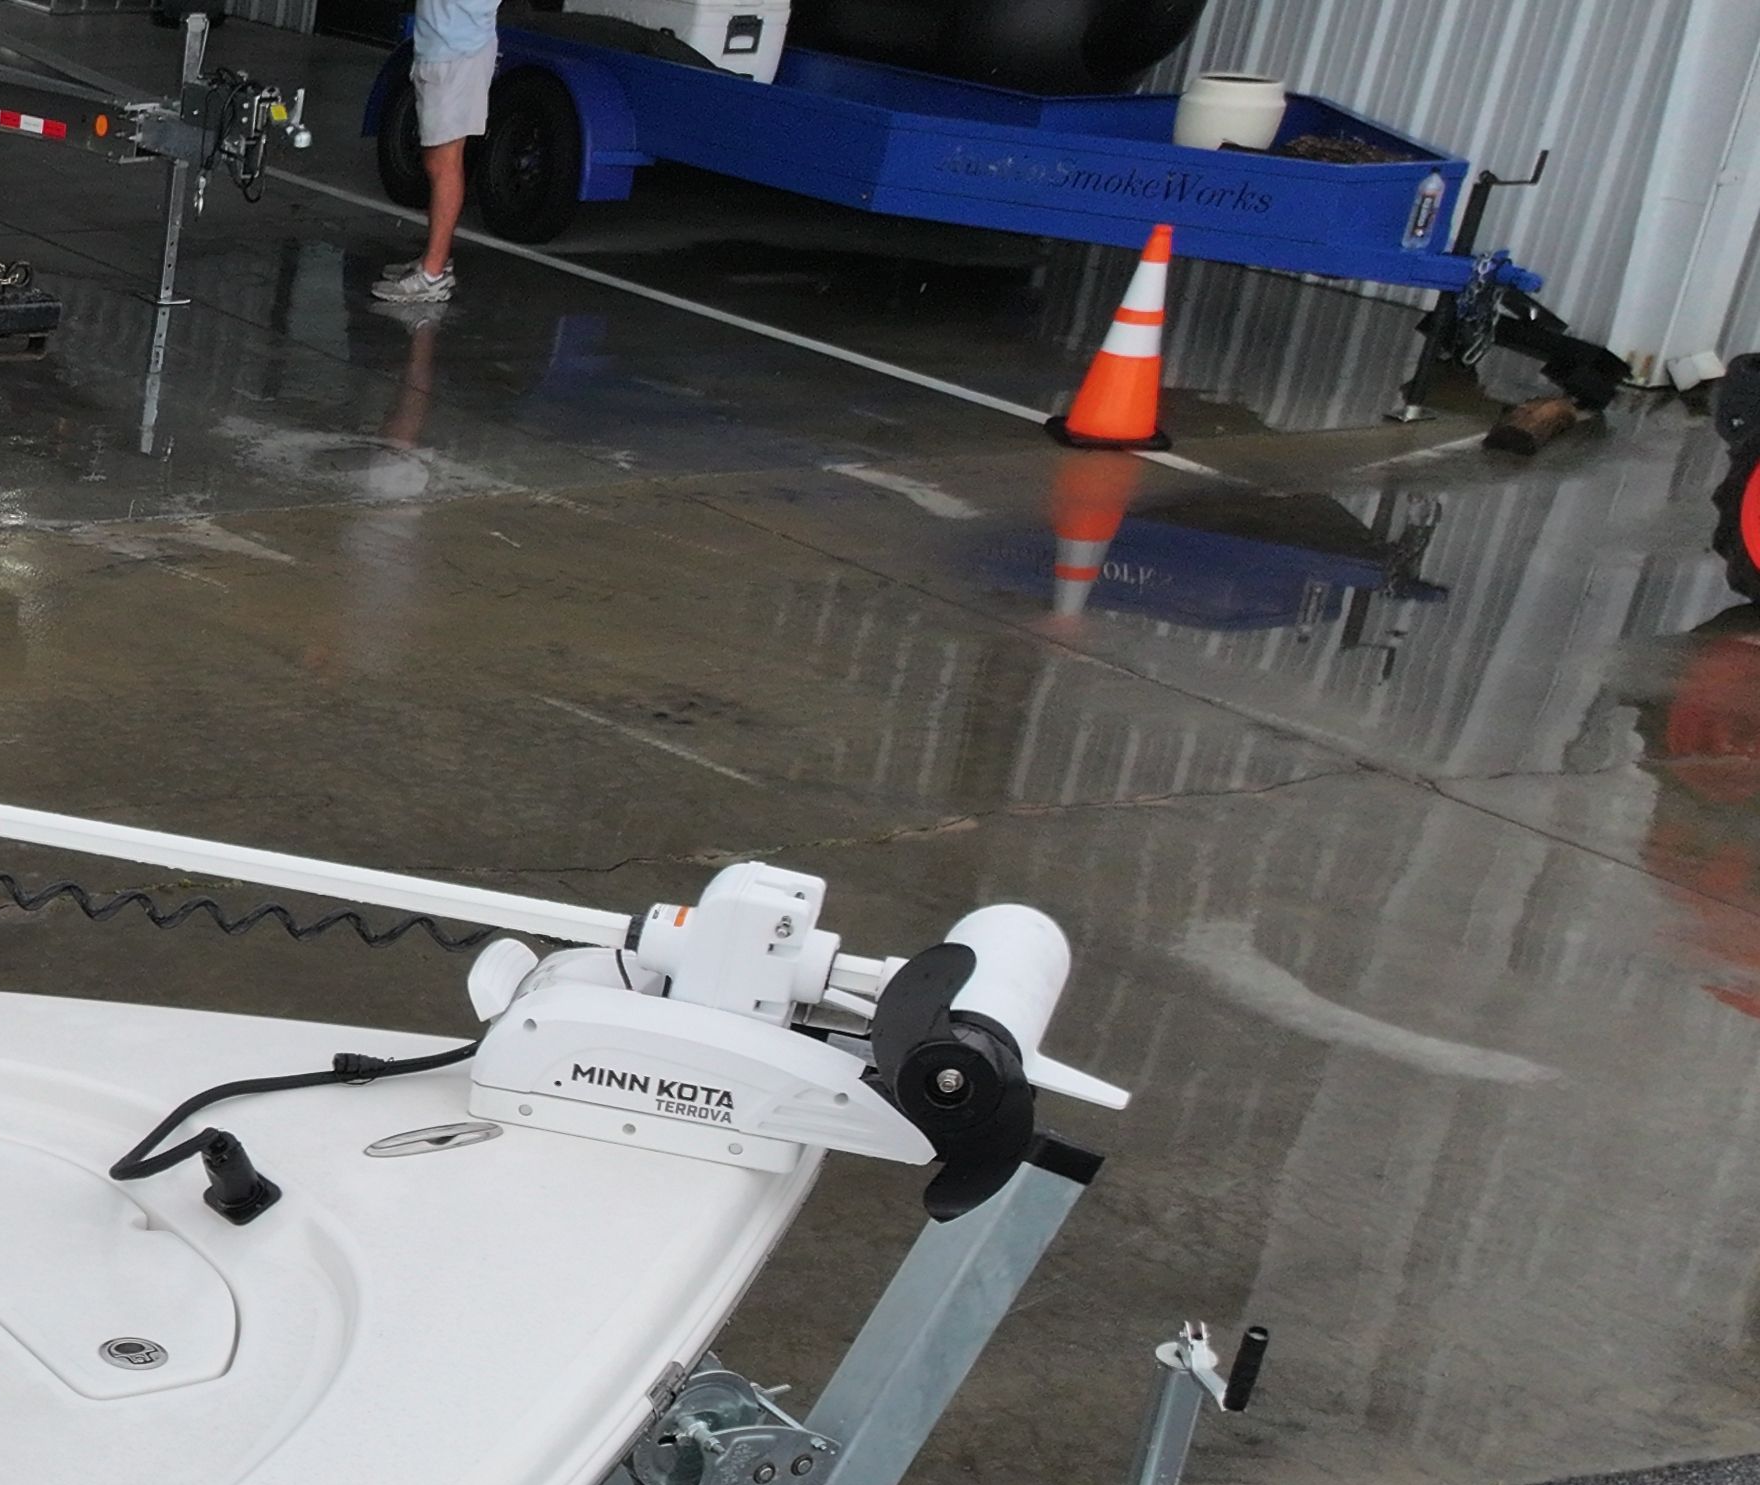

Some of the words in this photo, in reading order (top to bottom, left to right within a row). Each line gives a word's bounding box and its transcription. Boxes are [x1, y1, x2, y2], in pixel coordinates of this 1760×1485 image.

[1049, 156, 1274, 215] SmokeWorks
[571, 1063, 651, 1095] MINN
[656, 1078, 734, 1110] KOTA
[655, 1098, 733, 1124] TERROVA
